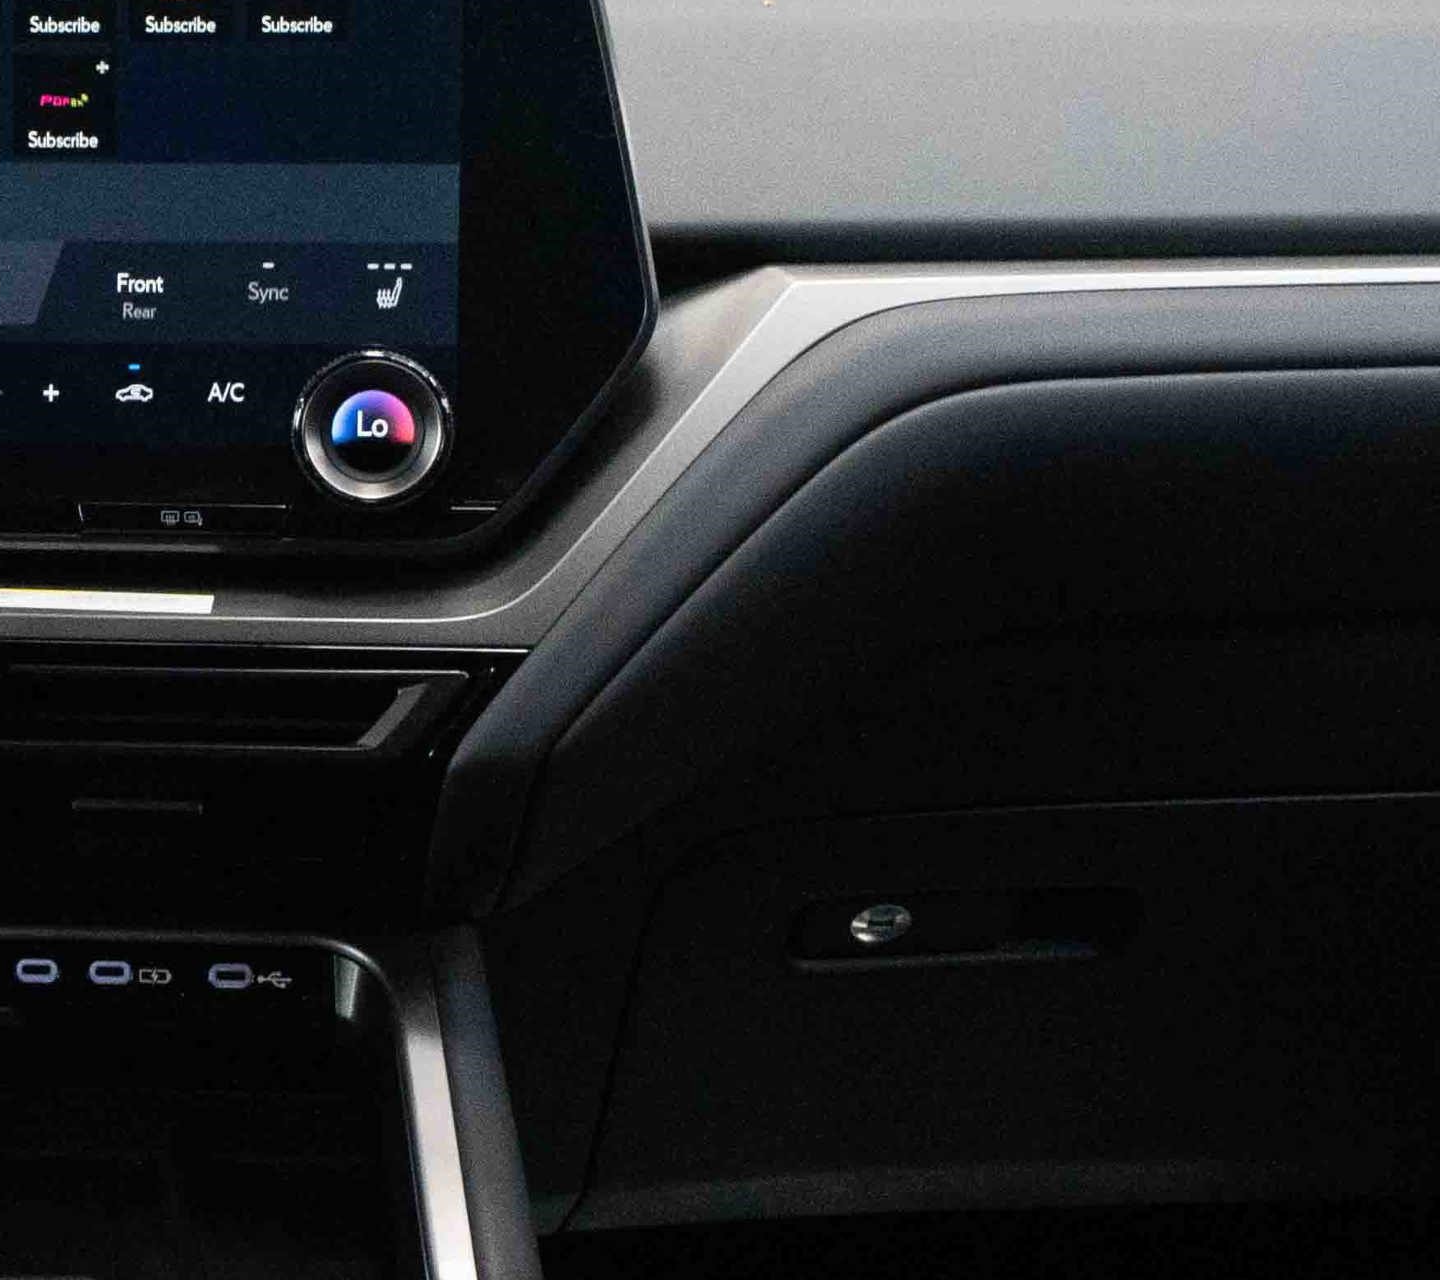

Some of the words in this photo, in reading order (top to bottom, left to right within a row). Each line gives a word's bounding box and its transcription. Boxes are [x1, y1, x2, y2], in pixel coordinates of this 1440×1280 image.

[29, 15, 101, 34] Subscribe
[144, 15, 217, 34] Subscribe
[260, 14, 334, 34] Subscribe
[27, 129, 100, 149] Subscribe
[116, 272, 165, 294] Front
[247, 281, 289, 304] Sync
[122, 302, 157, 320] Rear
[207, 381, 246, 403] A/C
[356, 410, 389, 440] Lo
